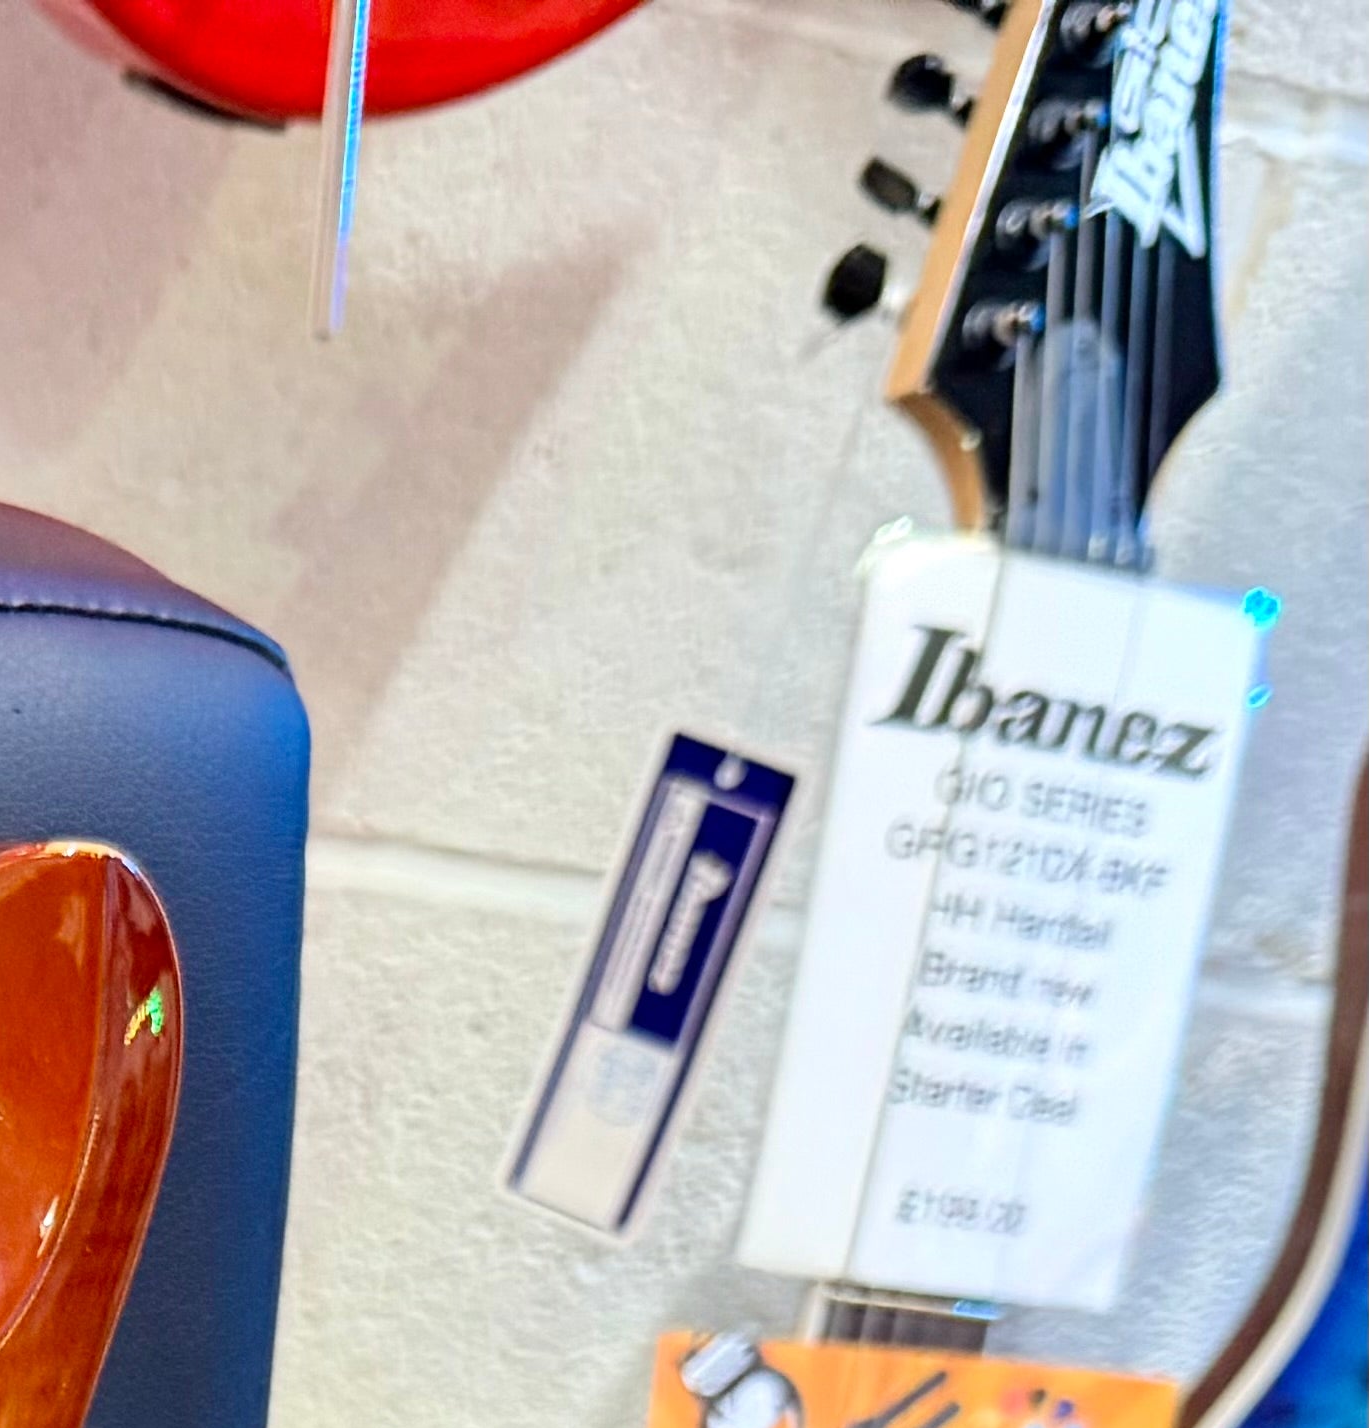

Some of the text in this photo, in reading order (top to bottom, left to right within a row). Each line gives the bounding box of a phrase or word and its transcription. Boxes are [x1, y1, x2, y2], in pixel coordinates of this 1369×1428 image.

[1085, 0, 1218, 258] Ibane
[869, 624, 1221, 778] Ibanez
[1019, 779, 1149, 838] SERIES
